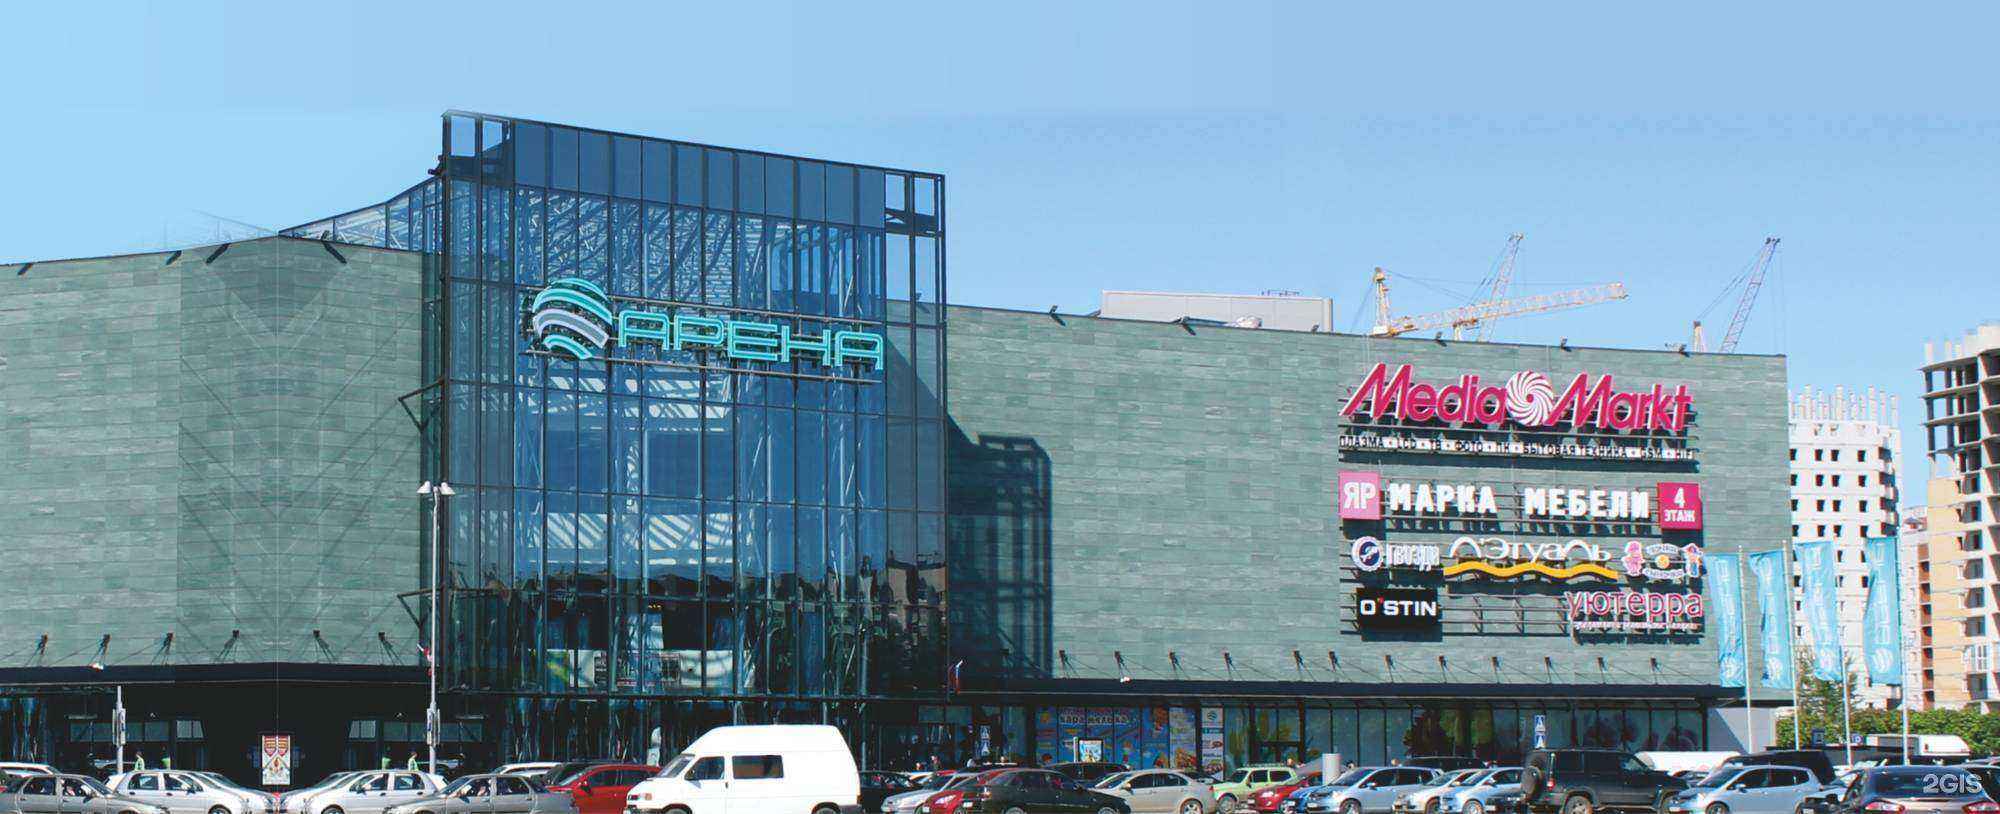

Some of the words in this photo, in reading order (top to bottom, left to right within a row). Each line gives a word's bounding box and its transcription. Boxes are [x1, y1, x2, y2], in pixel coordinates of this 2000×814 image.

[618, 309, 884, 371] АРЕНА
[1339, 362, 1507, 426] Media
[1547, 371, 1695, 432] Markt
[1340, 435, 1383, 448] ПЛАЗМА
[1398, 437, 1416, 449] LCD
[1455, 439, 1483, 452] ФОТО
[1640, 446, 1662, 458] GSM
[1524, 487, 1650, 518] МЕБЕЛИ
[1673, 487, 1686, 508] 4
[1664, 509, 1696, 522] ЭТАЖ
[1360, 596, 1437, 616] O'STIN
[1564, 591, 1704, 623] уютерра
